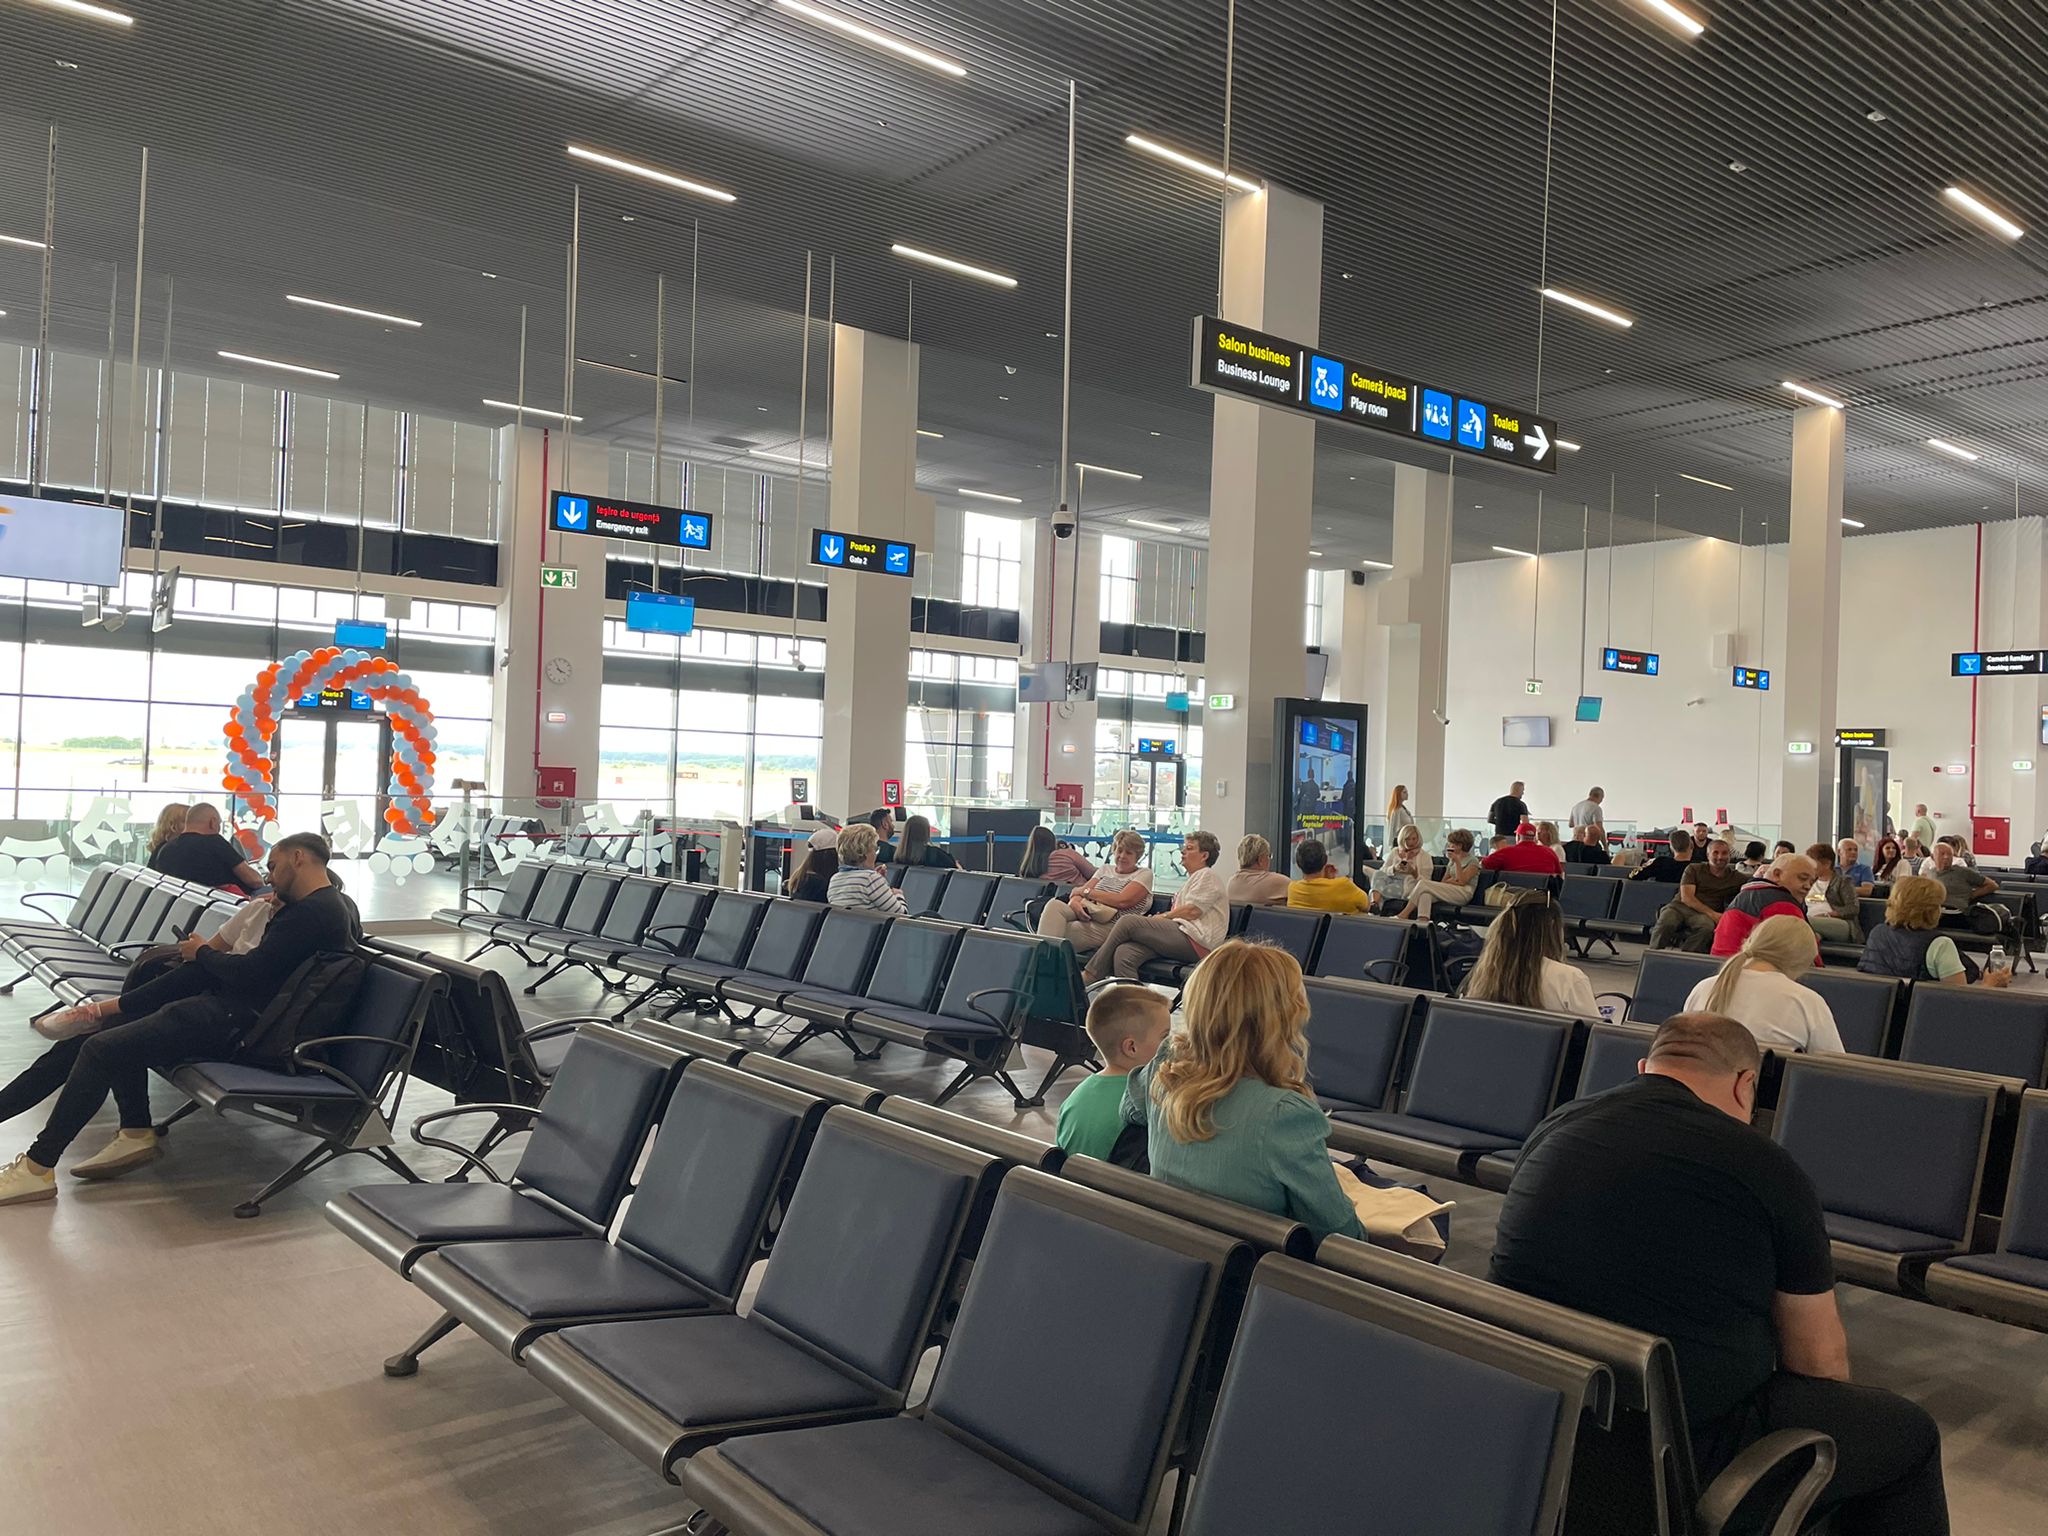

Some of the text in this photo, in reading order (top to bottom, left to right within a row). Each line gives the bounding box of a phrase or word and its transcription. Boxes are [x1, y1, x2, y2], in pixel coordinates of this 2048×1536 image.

[1218, 333, 1291, 368] Salon business
[1217, 359, 1291, 392] Business Lounge
[1351, 372, 1407, 402] Cameră joacă
[1350, 397, 1388, 418] Play room
[1493, 413, 1519, 433] Toaletă
[1492, 434, 1514, 452] Toilets
[619, 508, 630, 518] de
[596, 519, 649, 535] Emergency exit
[850, 541, 876, 553] Poarta 2
[849, 555, 863, 564] Gate
[634, 592, 640, 601] 2
